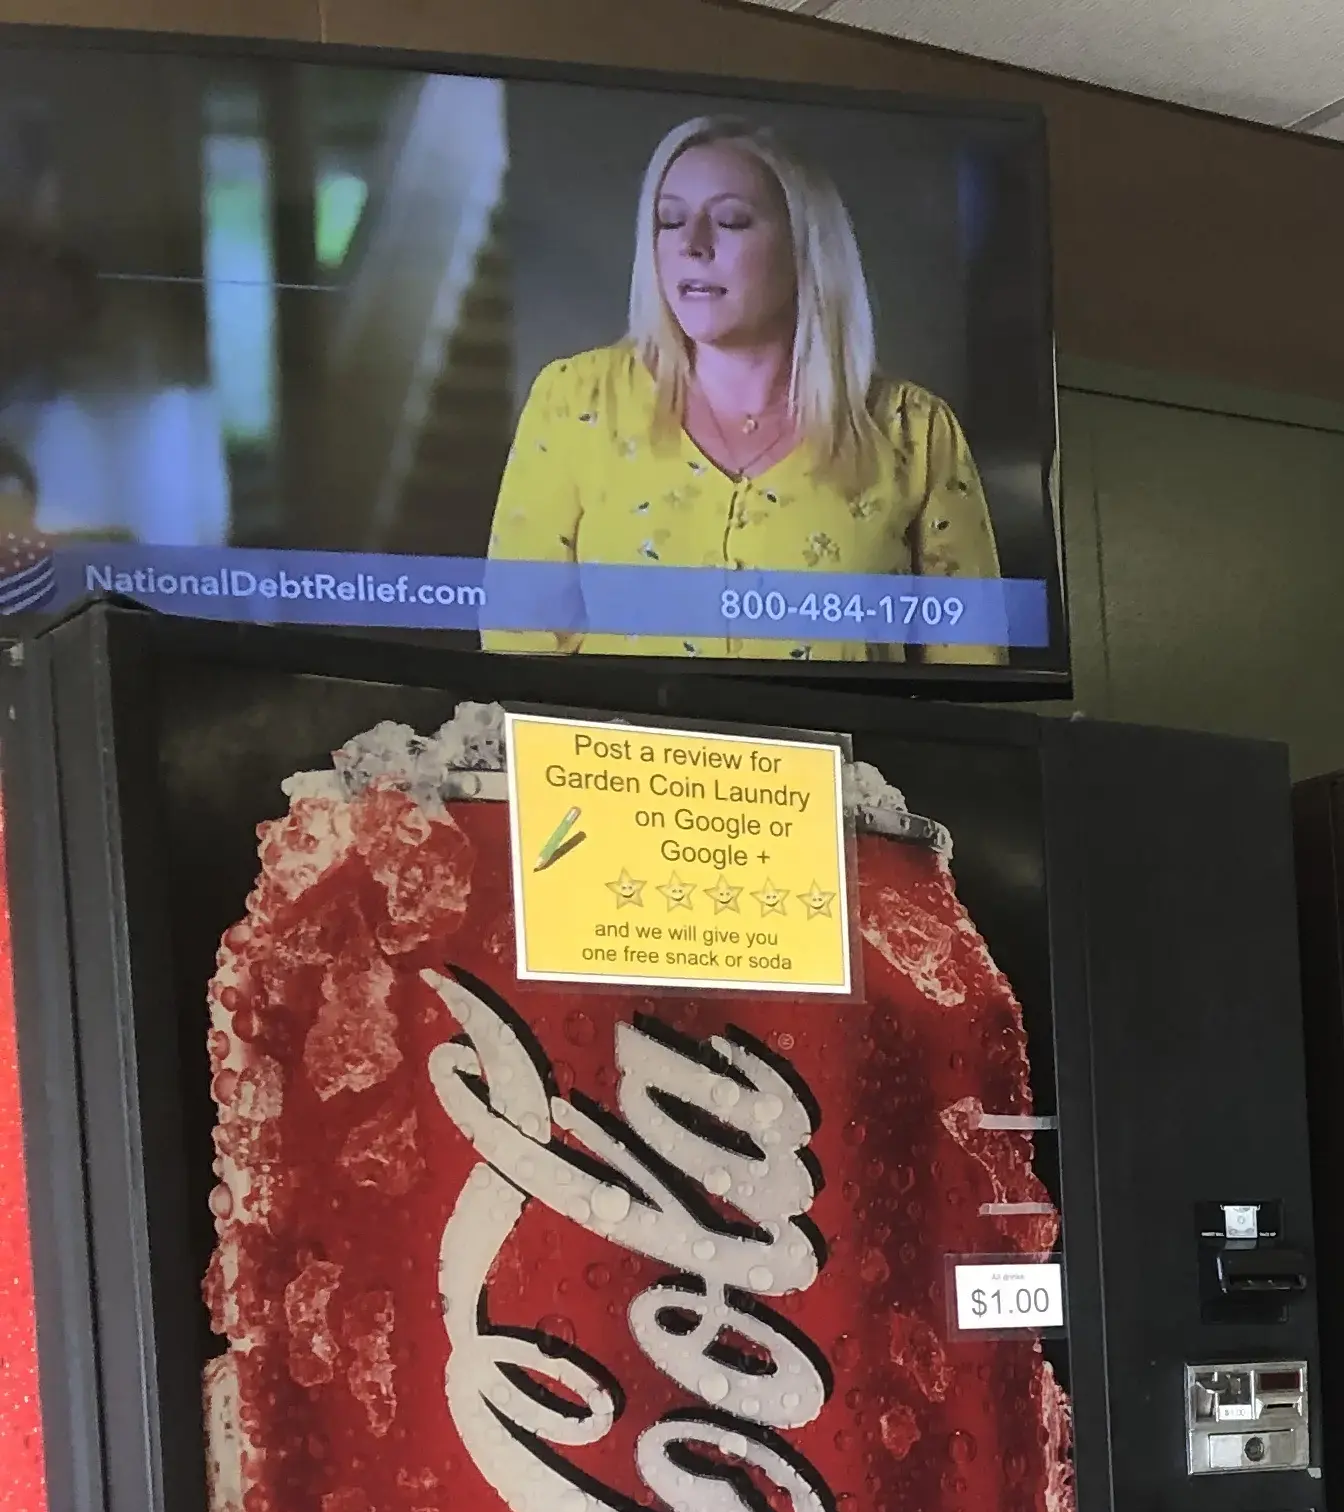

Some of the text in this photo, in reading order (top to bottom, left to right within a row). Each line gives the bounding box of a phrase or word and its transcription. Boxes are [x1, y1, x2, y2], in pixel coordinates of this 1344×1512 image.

[85, 563, 487, 608] NationalDebtRelief.com
[719, 589, 964, 627] 800-484-1709
[574, 734, 782, 773] Post a review for
[545, 764, 811, 812] Garden Coin Laundry
[634, 808, 793, 839] on Google or
[661, 839, 748, 869] Google
[594, 922, 778, 948] and we will give you
[582, 946, 792, 970] one free snack or soda
[970, 1287, 1050, 1319] $1.00
